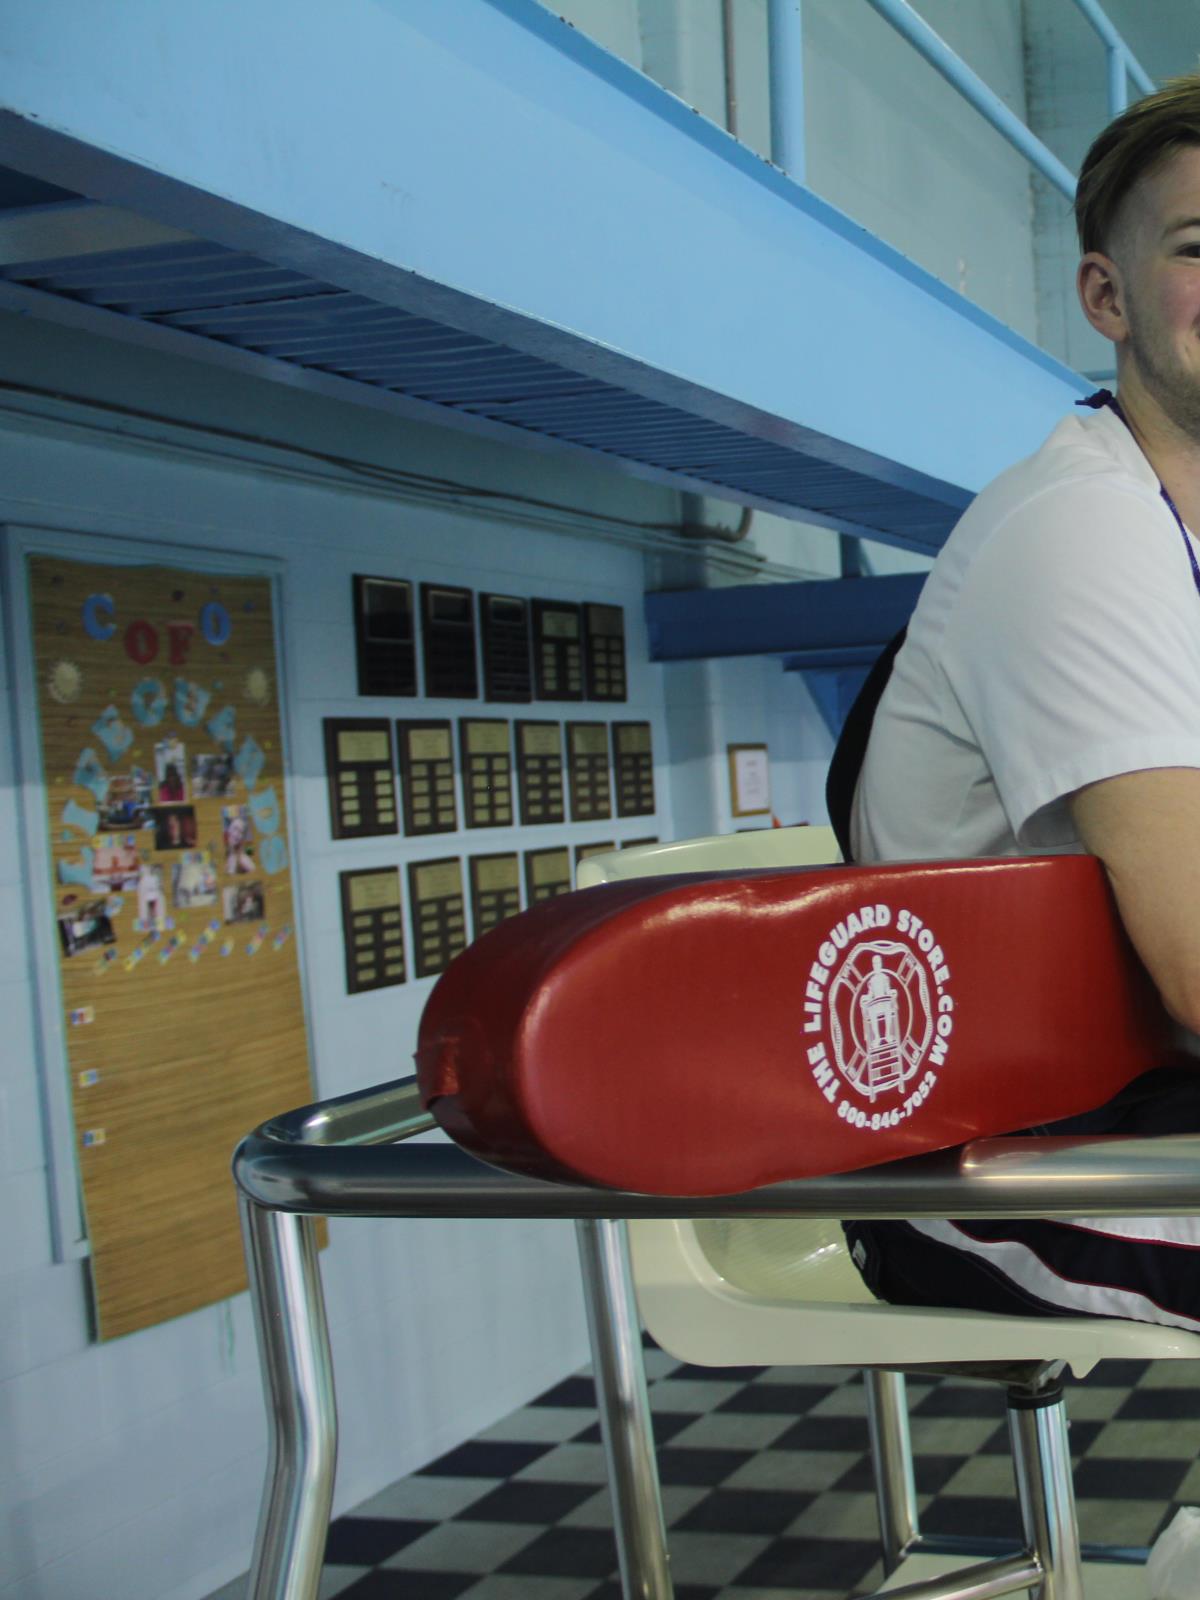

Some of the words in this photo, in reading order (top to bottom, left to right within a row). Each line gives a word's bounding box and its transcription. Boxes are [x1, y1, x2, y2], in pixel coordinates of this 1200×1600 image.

[804, 904, 891, 1032] LIFEGUARD
[896, 909, 953, 1066] STORE.COM
[807, 1042, 840, 1102] THE
[837, 1071, 937, 1130] 800-846-7052
